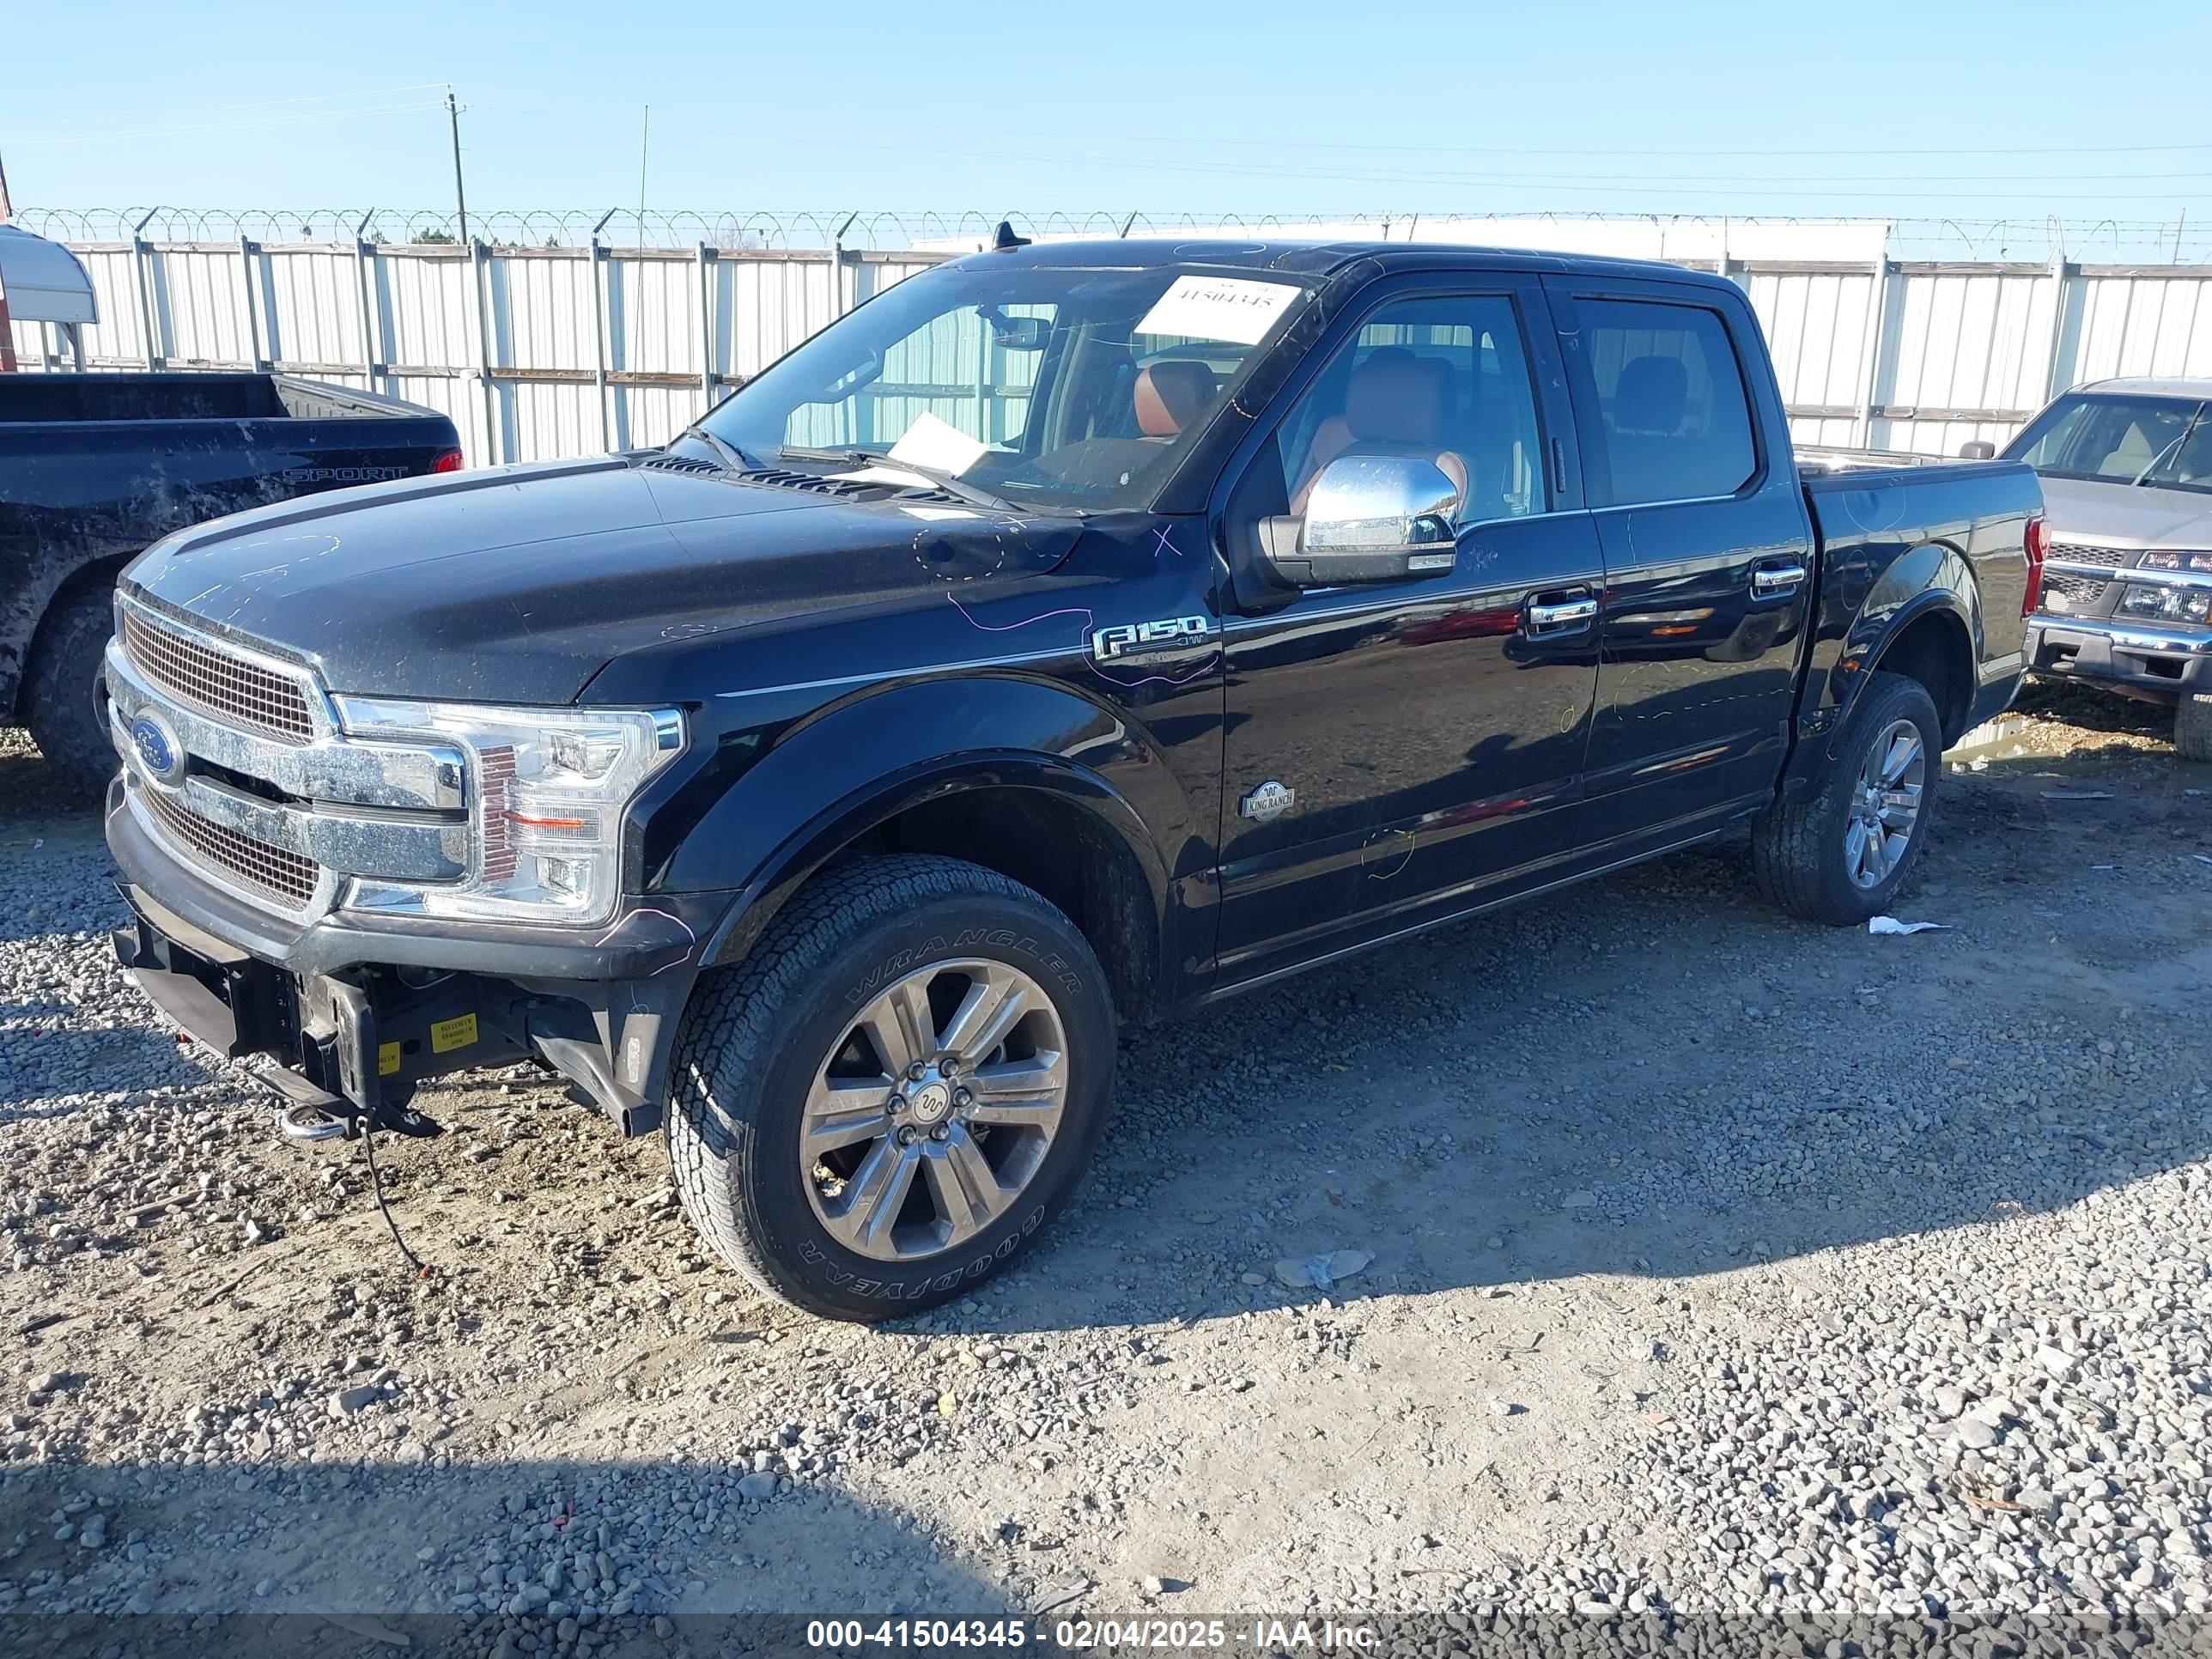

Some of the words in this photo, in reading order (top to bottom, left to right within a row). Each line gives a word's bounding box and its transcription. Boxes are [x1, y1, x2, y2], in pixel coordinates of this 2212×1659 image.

[283, 466, 409, 482] SPORT
[1249, 798, 1267, 813] KING
[1268, 792, 1293, 808] RANCH
[845, 928, 1083, 1004] WRANGLER
[797, 1205, 1045, 1299] GOODYEAR
